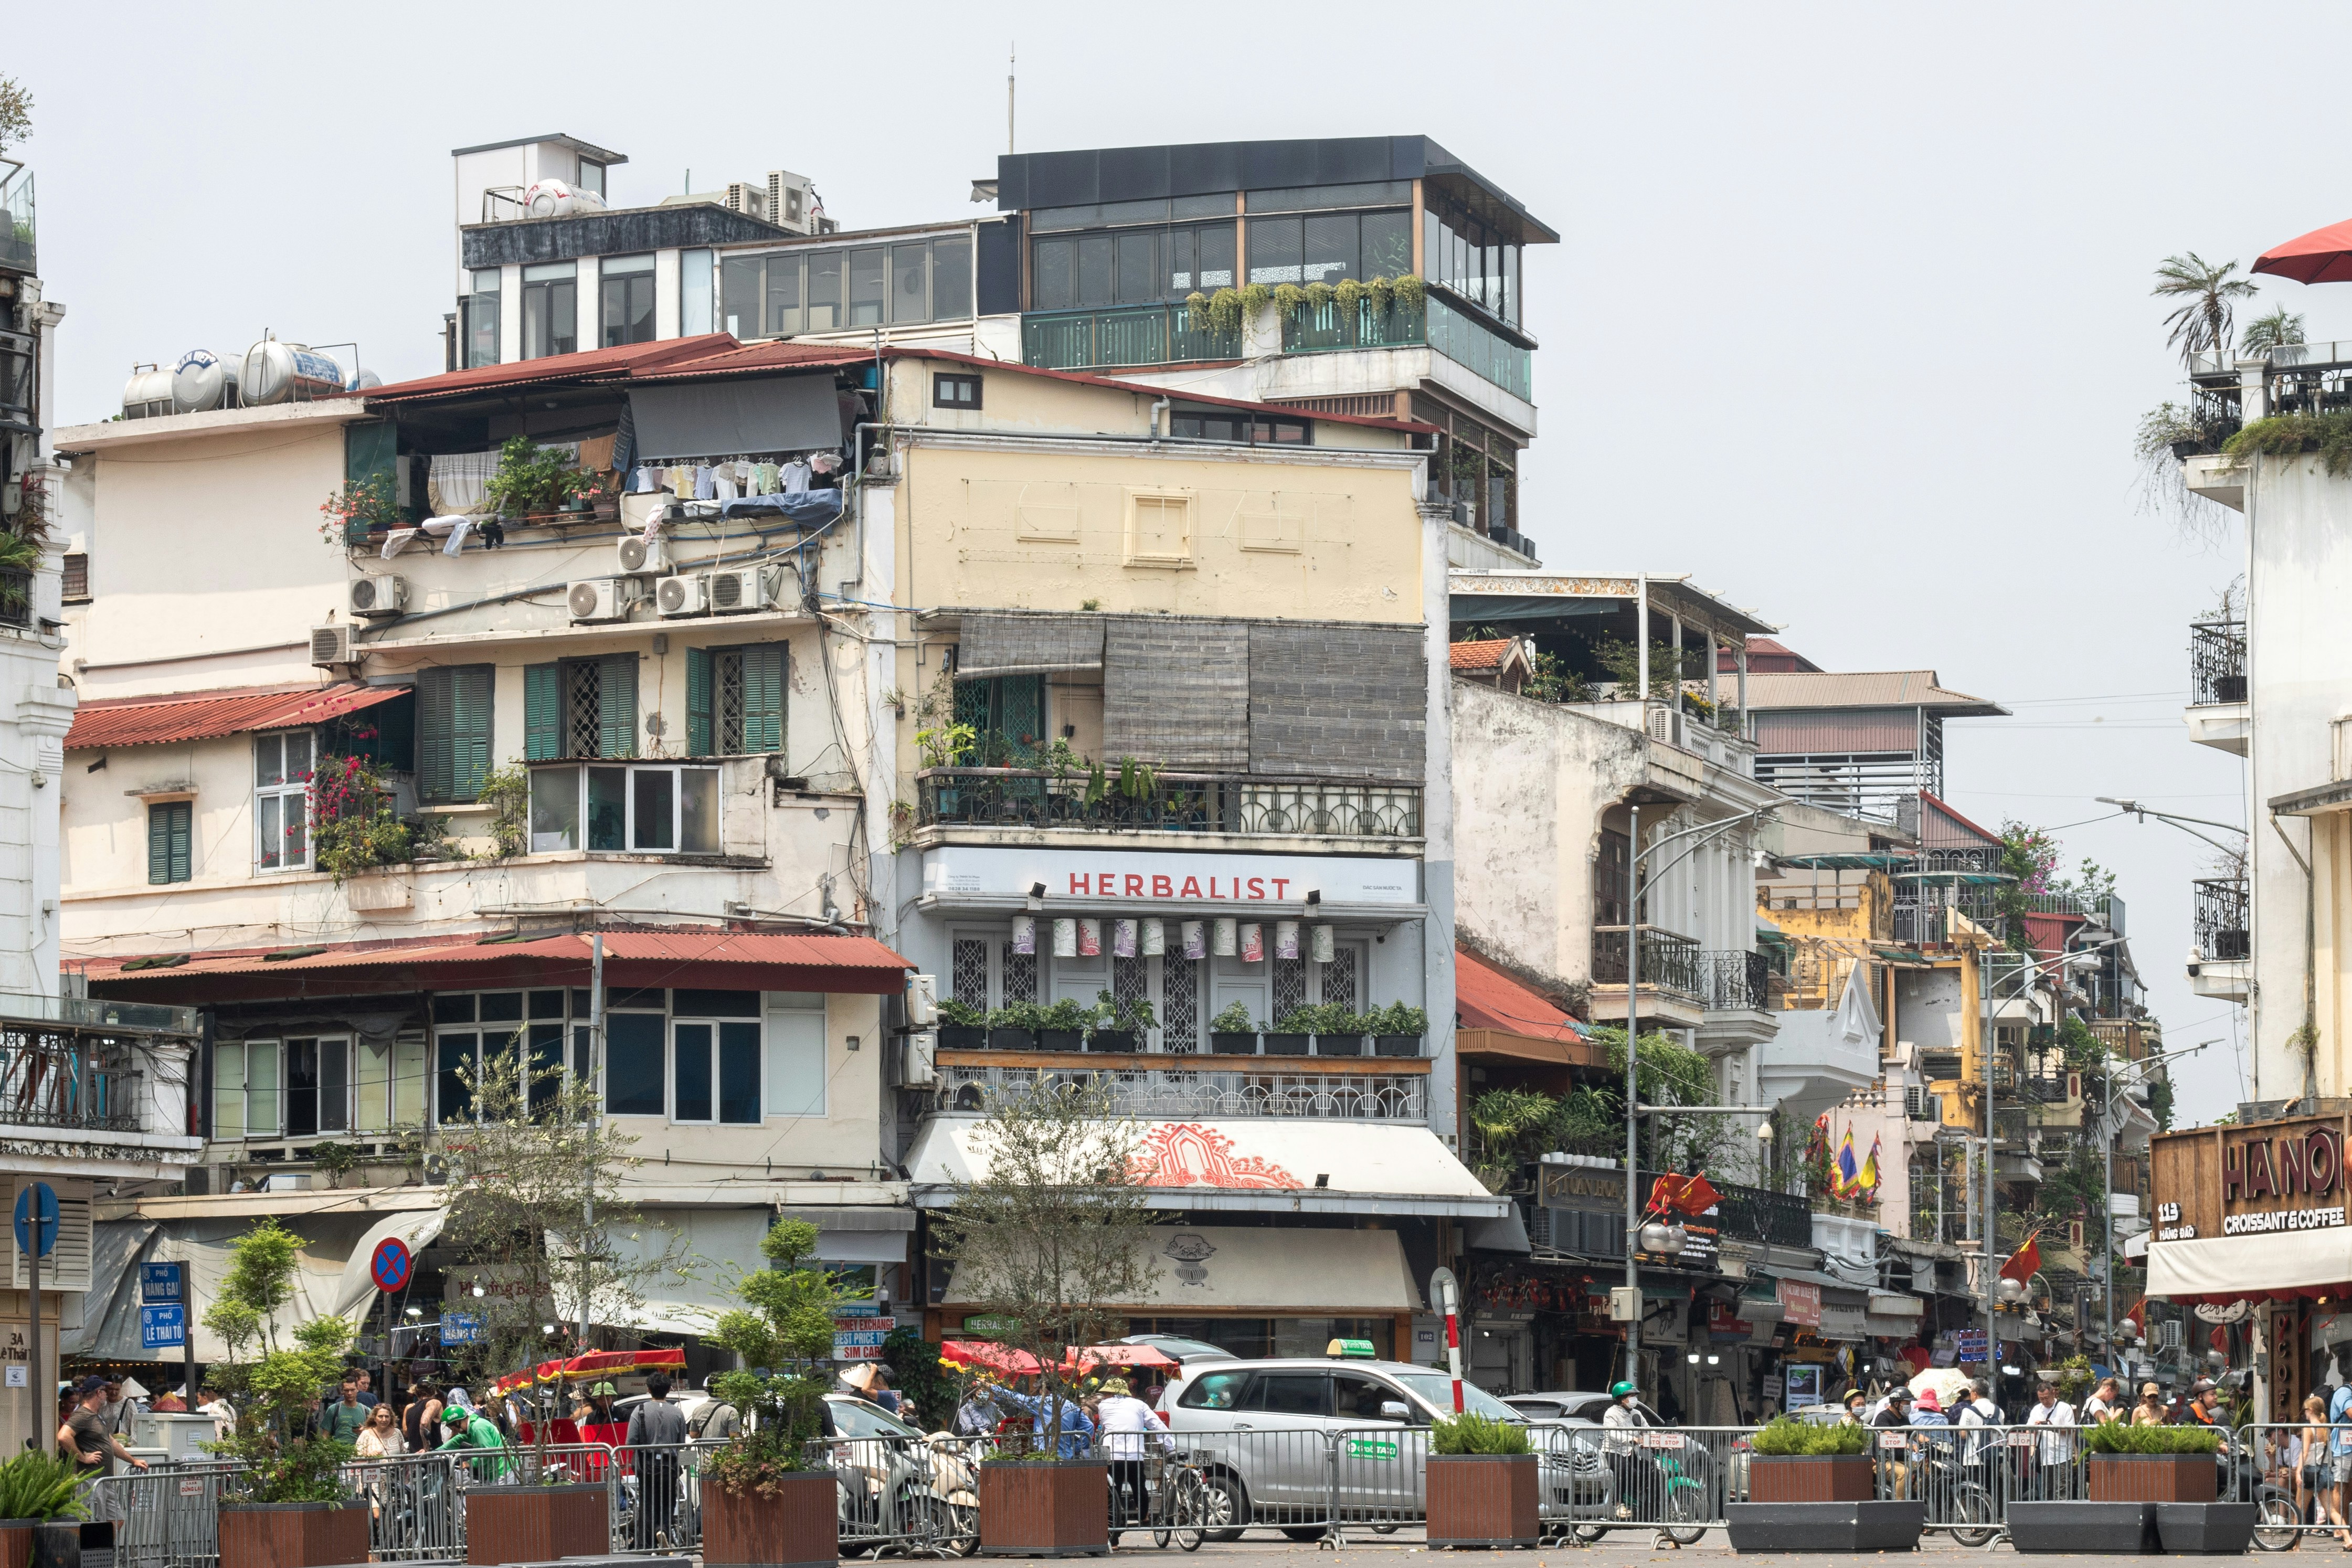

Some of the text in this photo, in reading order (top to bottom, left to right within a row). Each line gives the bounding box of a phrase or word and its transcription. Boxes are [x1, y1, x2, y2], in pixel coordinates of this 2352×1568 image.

[1070, 873, 1289, 900] HERBALIST
[2158, 1202, 2178, 1222] 113
[155, 1268, 168, 1277] PHỐ
[145, 1280, 178, 1296] HÀNG GAI
[159, 1309, 173, 1319] PHỐ
[146, 1319, 182, 1341] LÊ THÁI TỔ
[834, 1318, 894, 1331] MONEY EXCHANGE
[10, 1333, 24, 1345] 3A
[834, 1332, 852, 1345] BEST
[853, 1332, 874, 1344] PRICE
[7, 1347, 27, 1360] Thái
[844, 1347, 861, 1358] SIM
